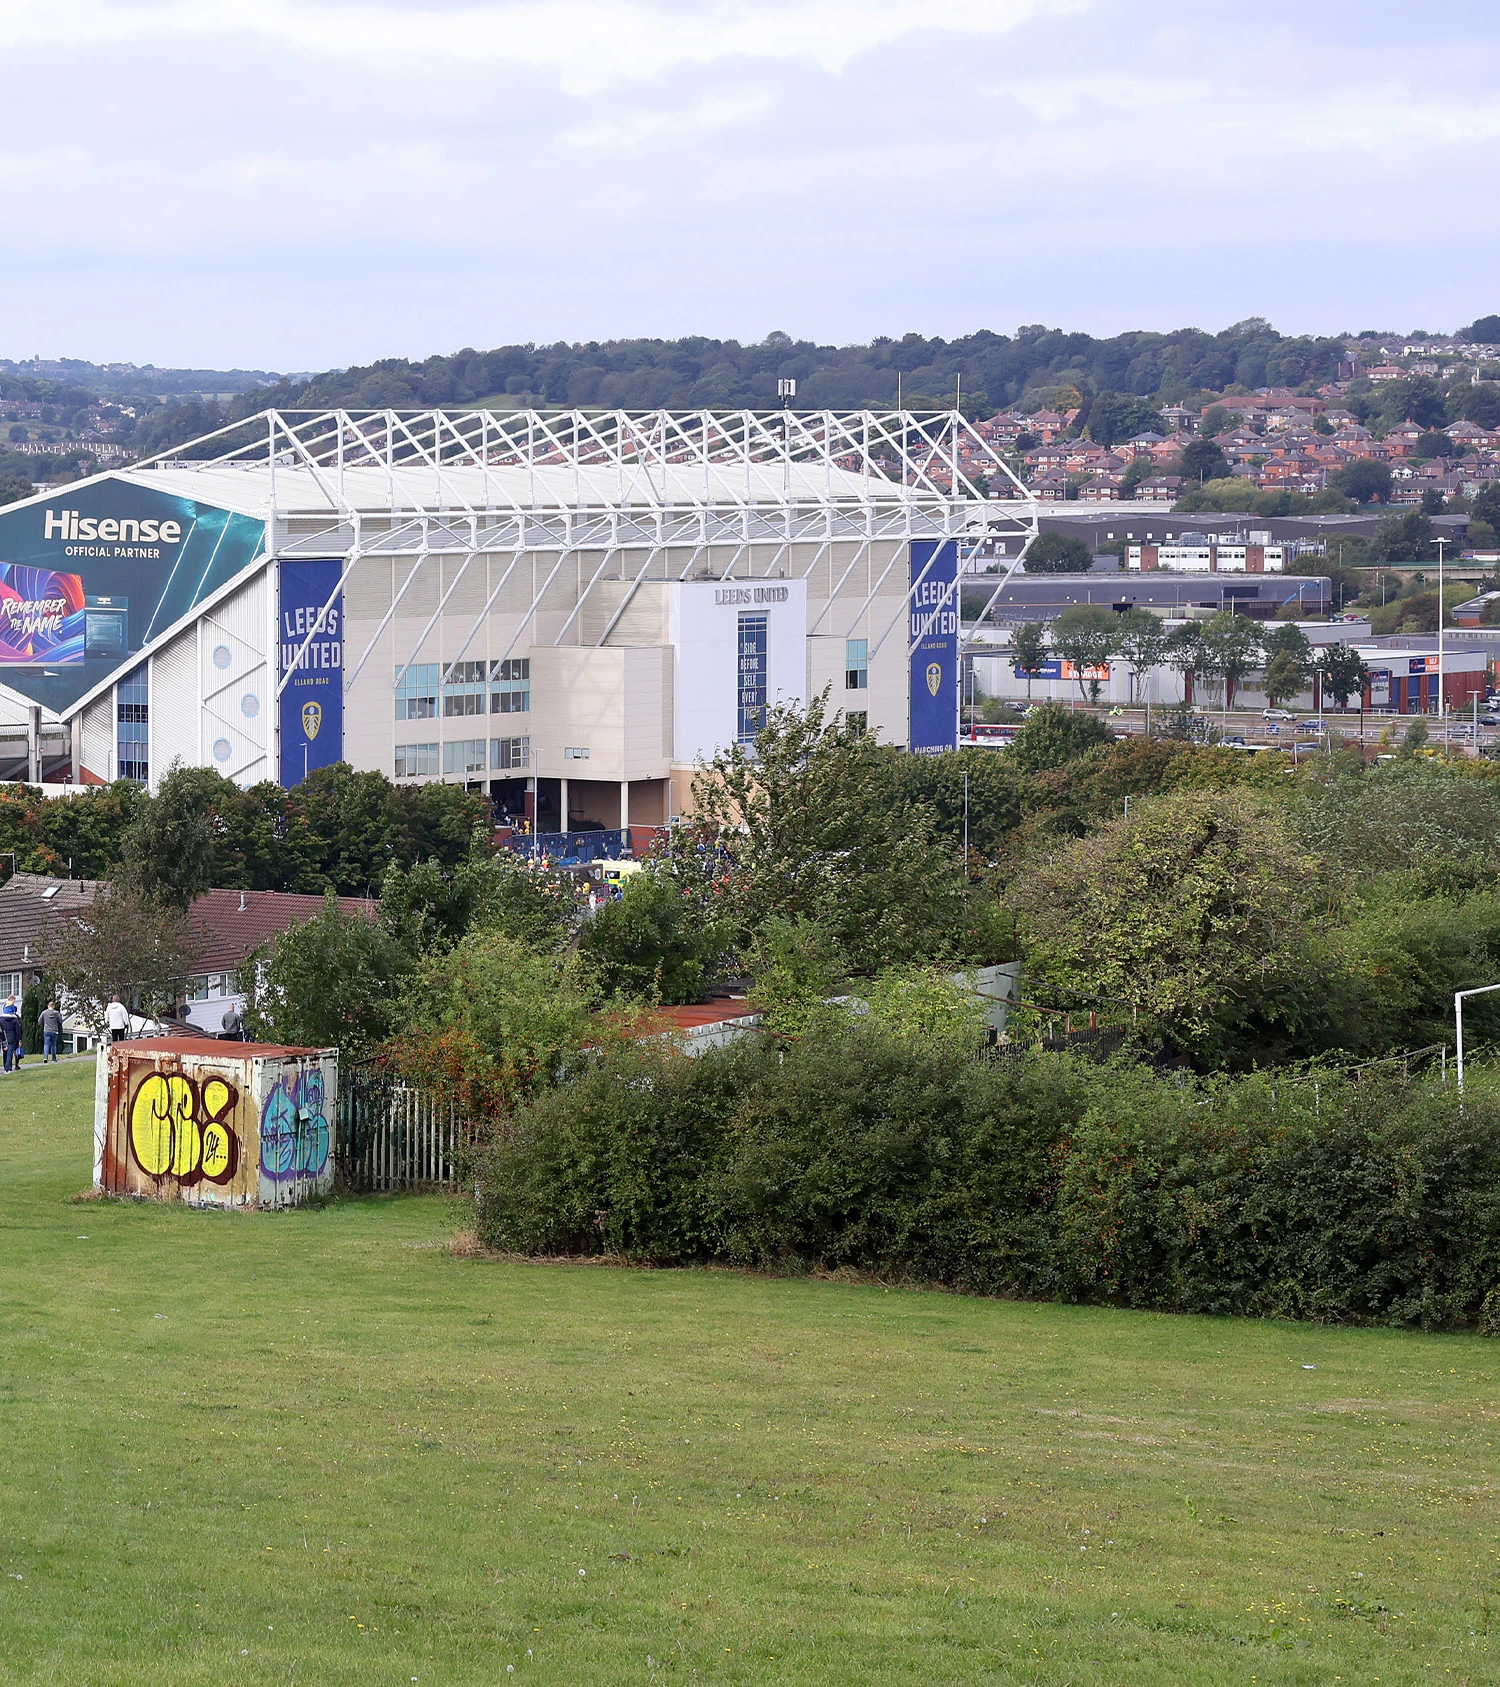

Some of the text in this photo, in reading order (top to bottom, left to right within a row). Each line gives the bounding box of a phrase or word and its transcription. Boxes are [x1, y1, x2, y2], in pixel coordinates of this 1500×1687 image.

[44, 509, 181, 544] Hisense
[65, 546, 160, 559] OFFICIAL PARTNER
[715, 586, 789, 605] LEEDS UNITED
[914, 581, 953, 608] LEEDS
[1, 598, 66, 620] REMEMBER
[10, 618, 23, 630] THE
[284, 606, 339, 638] LEEDS
[911, 611, 956, 636] UNITED
[281, 641, 341, 670] UNITED
